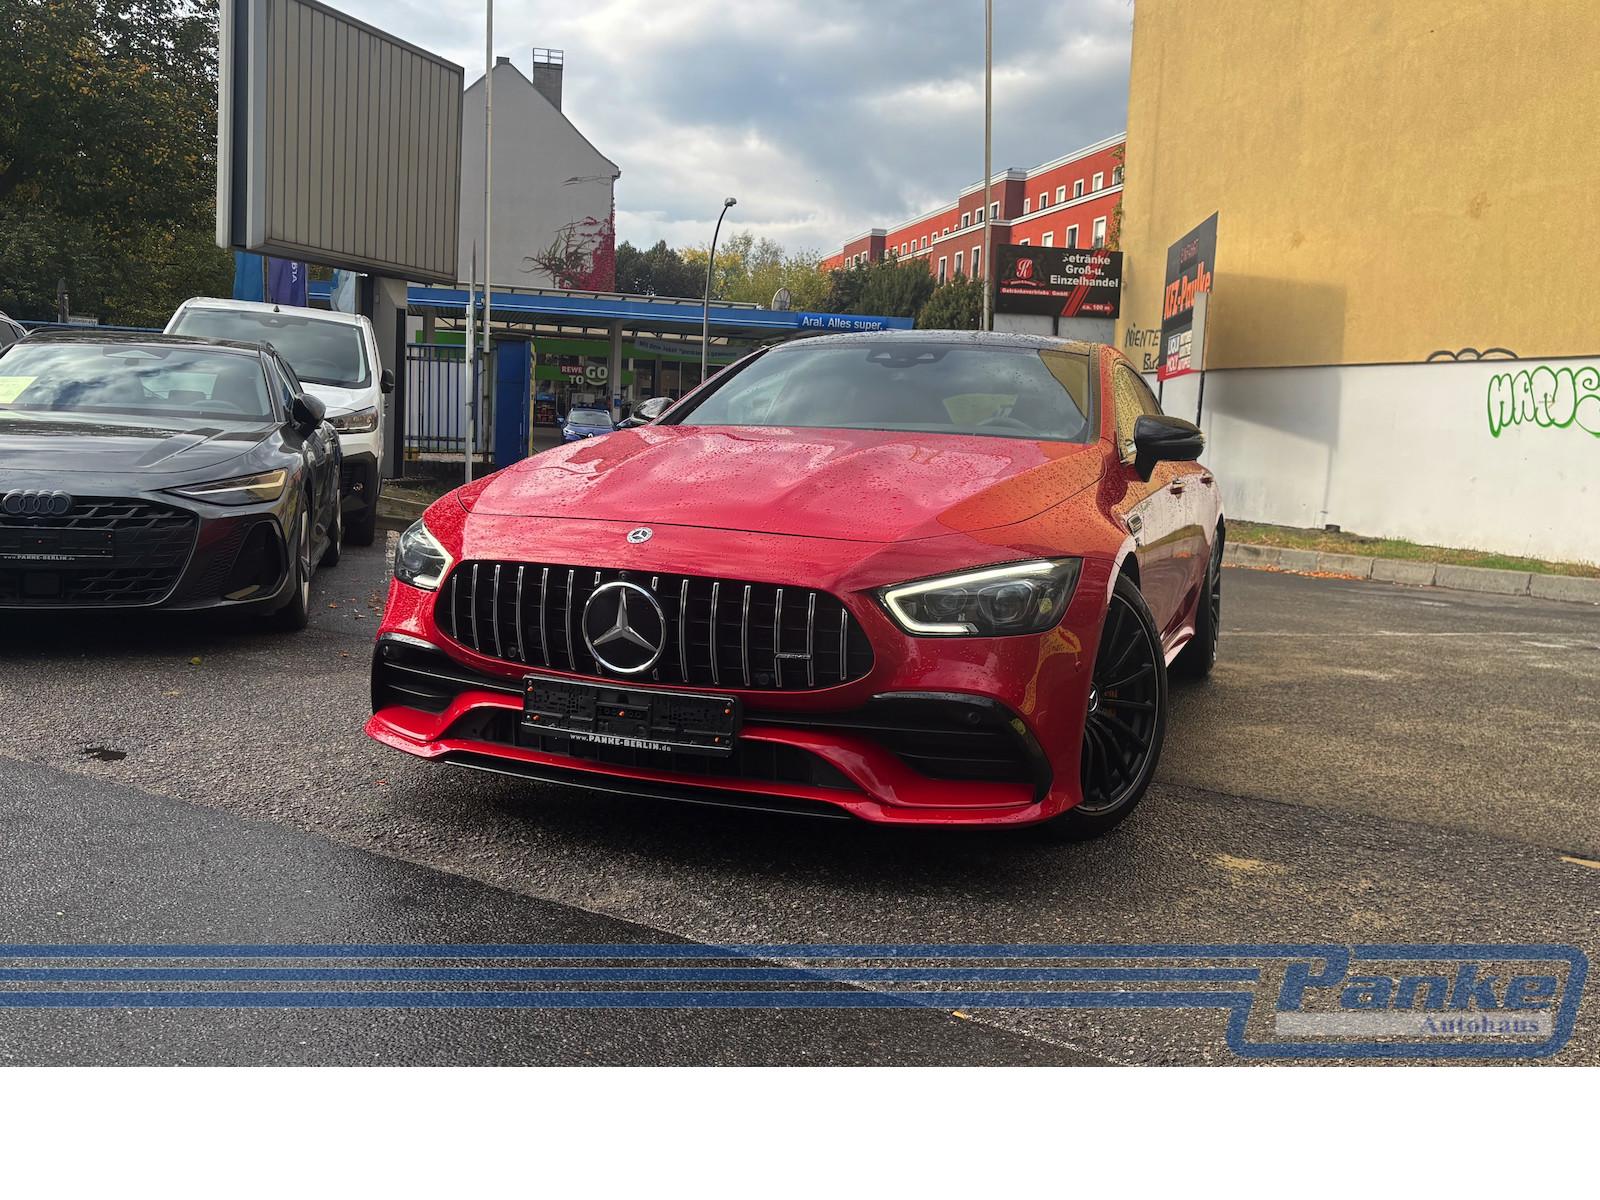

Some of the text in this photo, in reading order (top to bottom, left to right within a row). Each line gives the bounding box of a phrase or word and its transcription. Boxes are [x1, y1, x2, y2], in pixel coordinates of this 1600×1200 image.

[1050, 274, 1119, 288] Einzelhandel
[802, 315, 883, 332] Aral. Alles super.
[561, 365, 583, 374] REWE
[569, 365, 608, 385] TO GO
